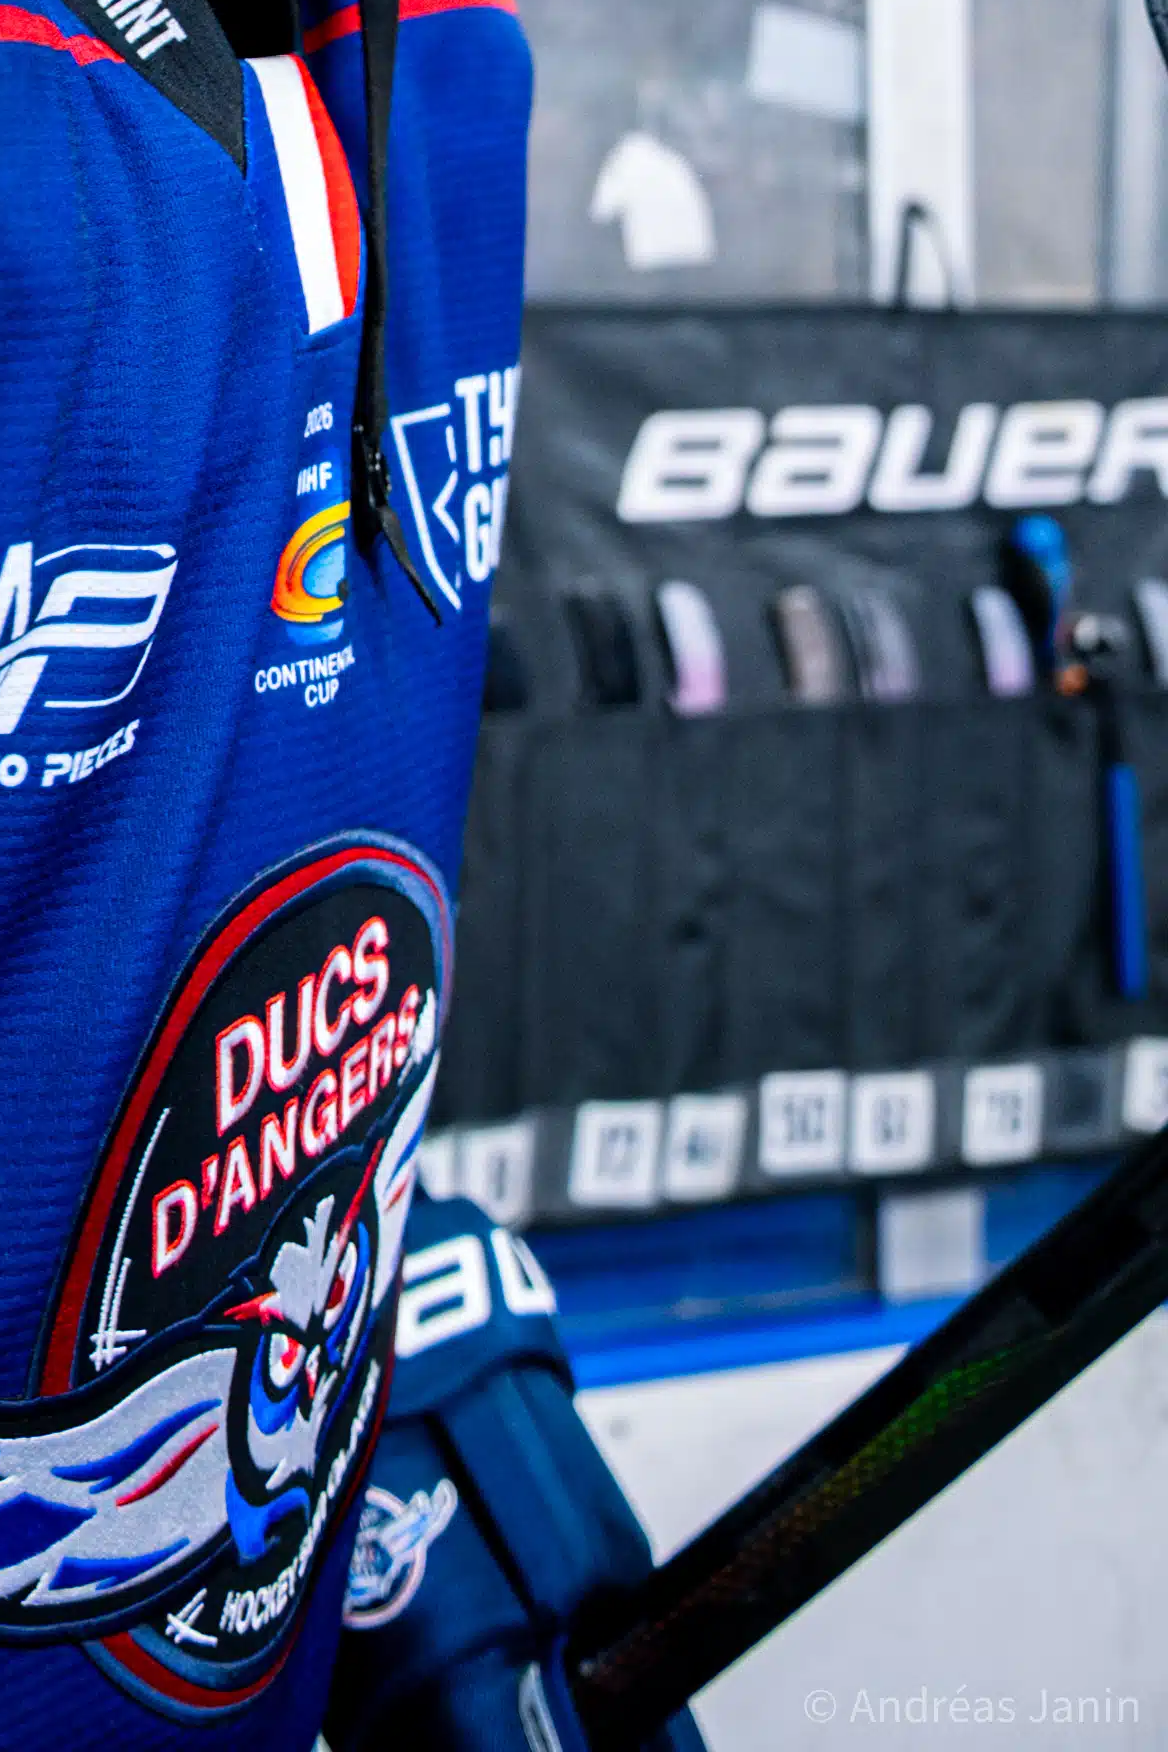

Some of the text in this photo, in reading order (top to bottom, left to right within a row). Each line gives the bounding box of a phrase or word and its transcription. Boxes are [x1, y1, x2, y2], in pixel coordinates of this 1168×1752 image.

[41, 719, 141, 788] PIECES
[304, 677, 339, 708] CUP
[214, 915, 390, 1138] DUCS
[151, 983, 420, 1279] D'ANGERS
